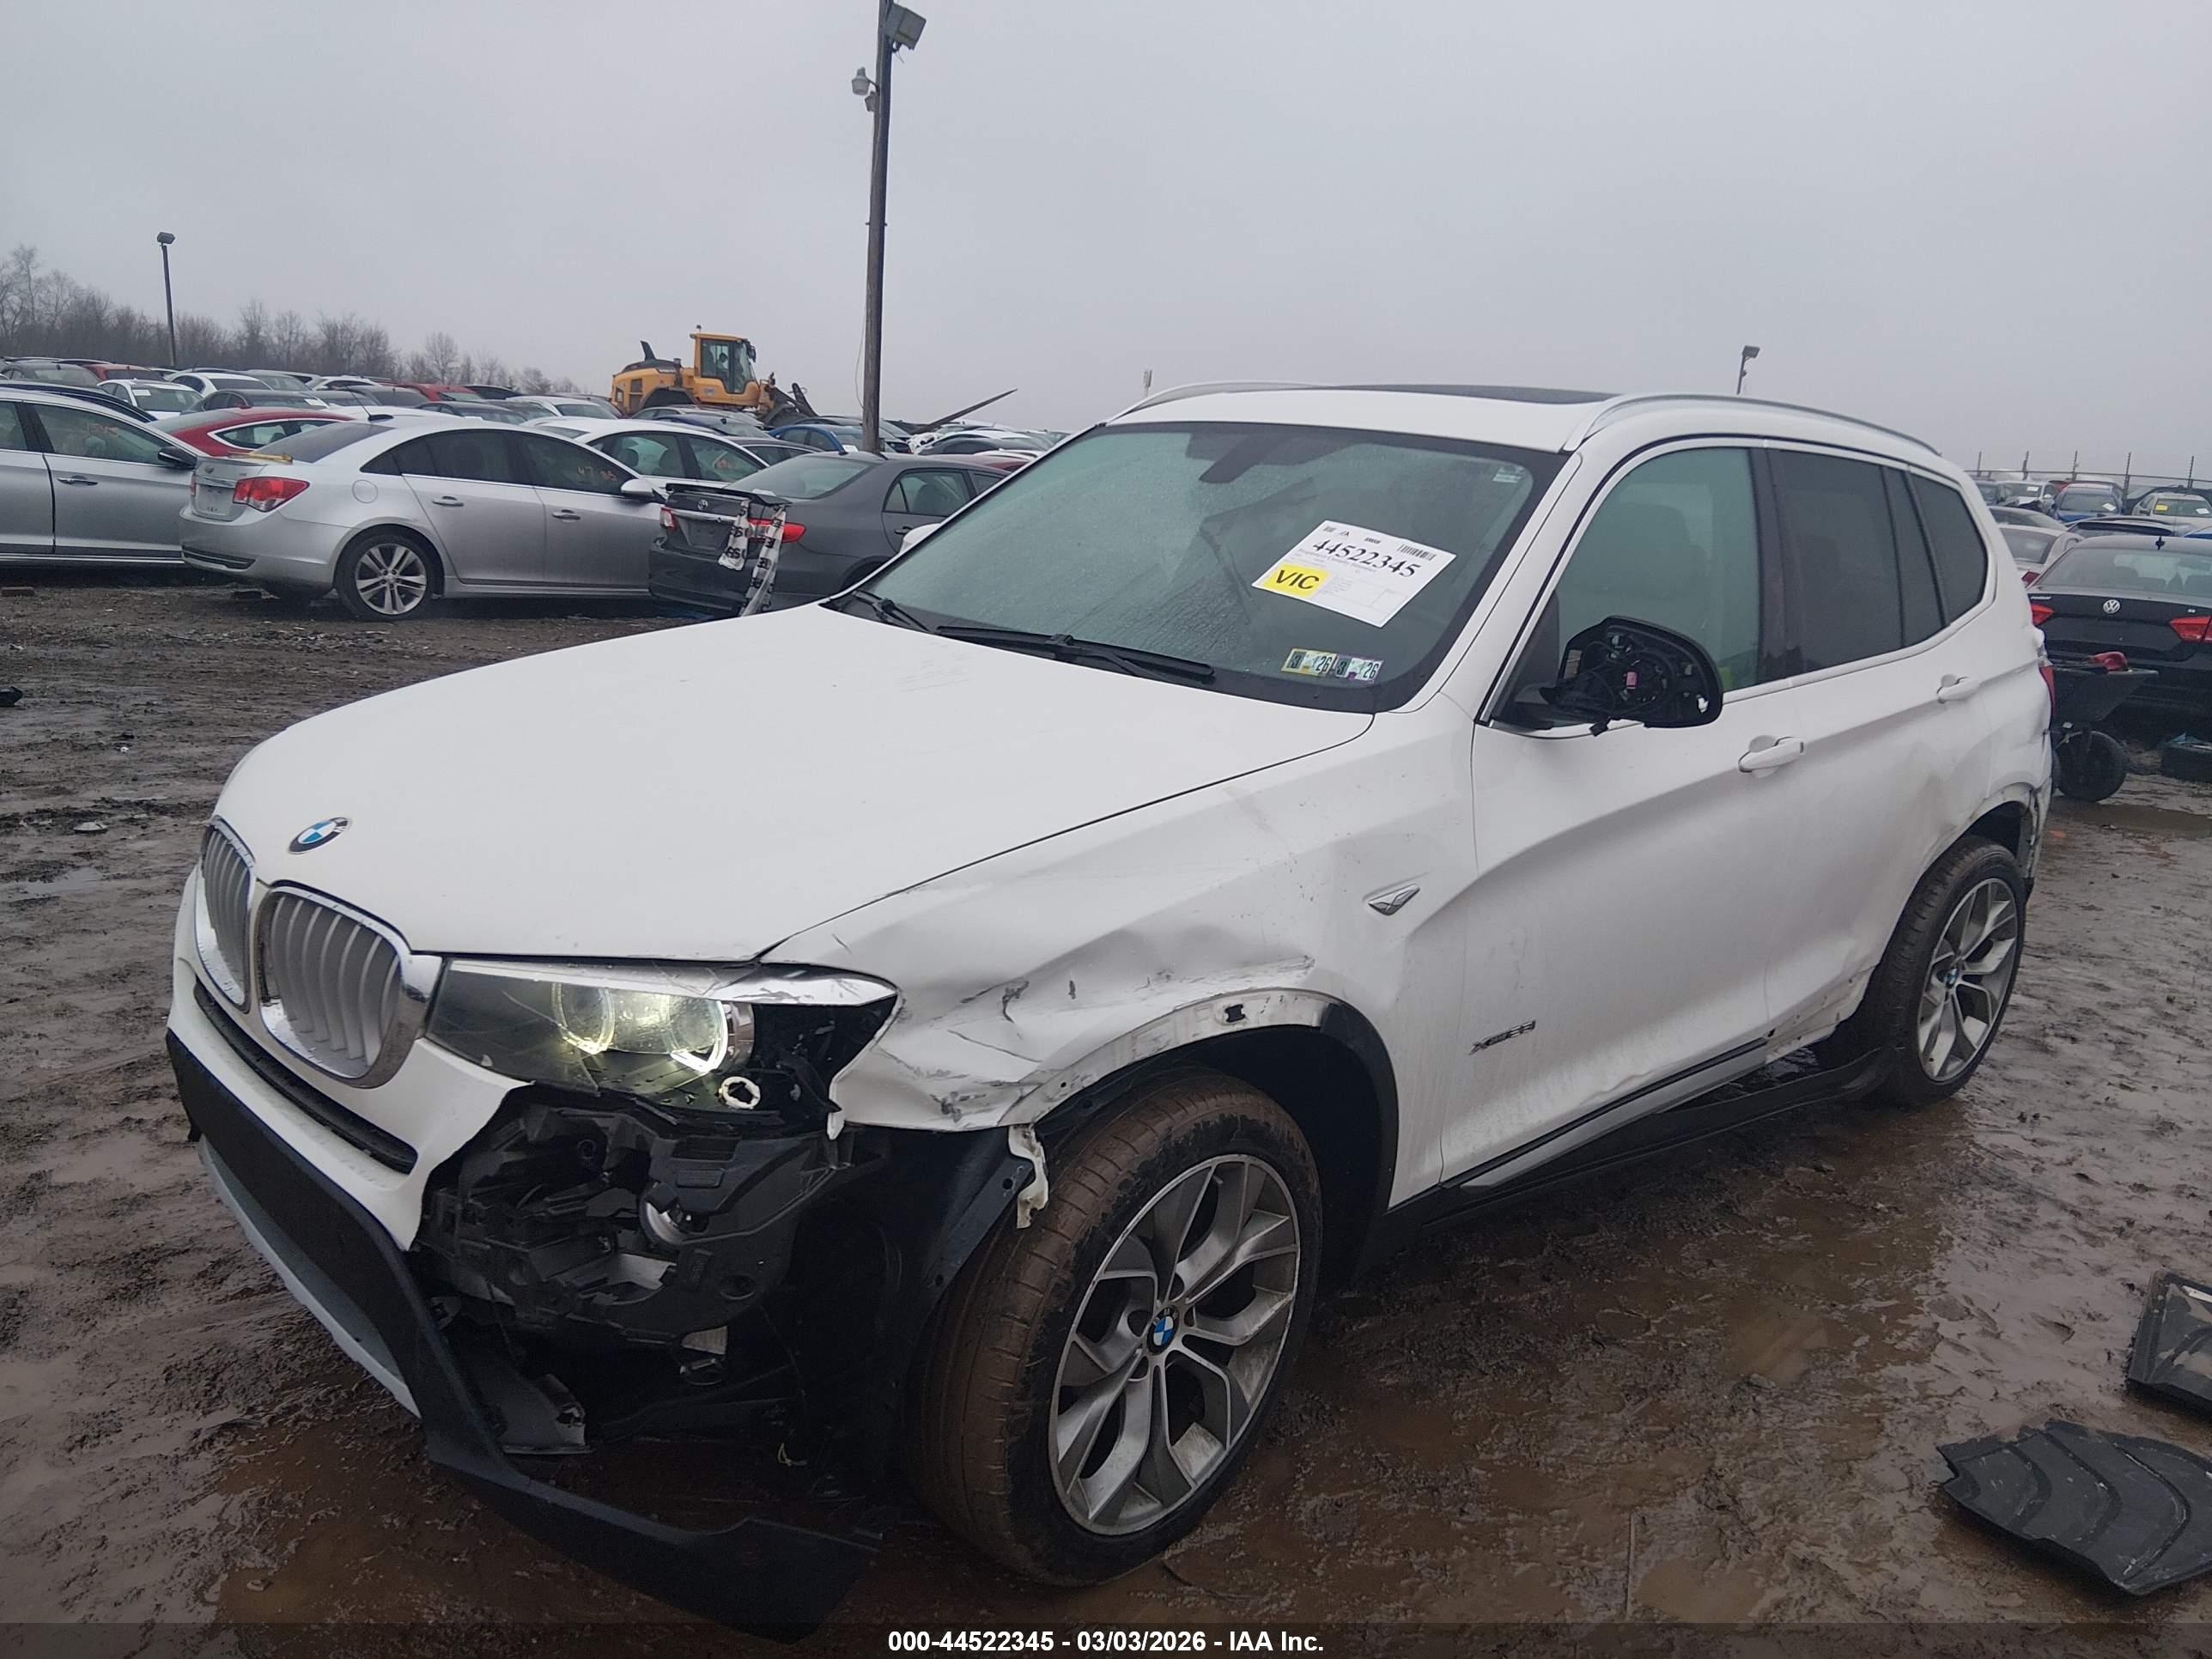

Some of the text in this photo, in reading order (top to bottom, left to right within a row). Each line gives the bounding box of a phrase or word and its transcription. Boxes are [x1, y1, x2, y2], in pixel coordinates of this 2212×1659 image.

[1313, 539, 1422, 578] 44522345
[1276, 569, 1320, 590] VIC
[1291, 654, 1333, 672] 3 26
[1336, 660, 1379, 678] 3 26
